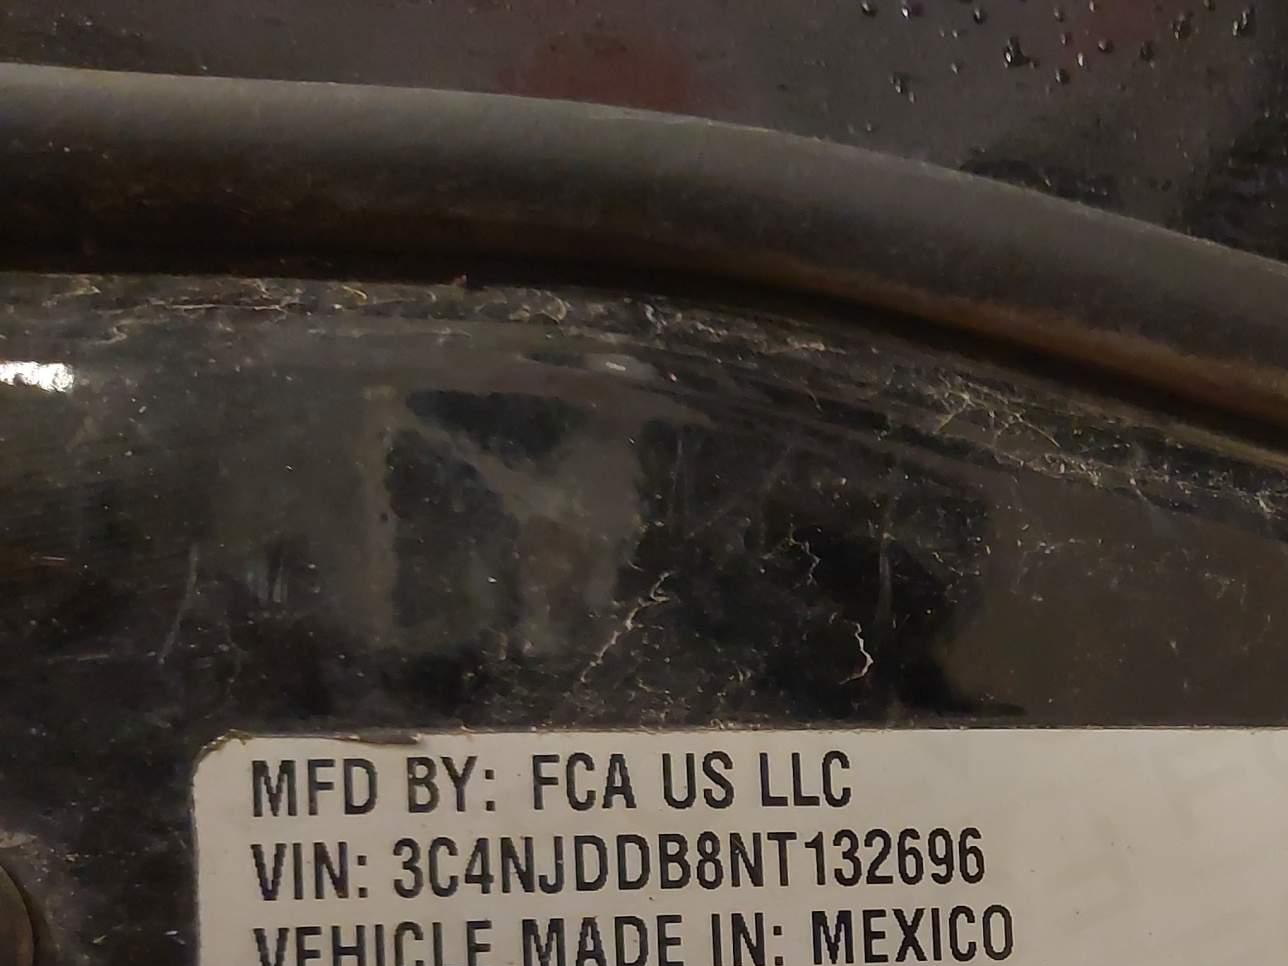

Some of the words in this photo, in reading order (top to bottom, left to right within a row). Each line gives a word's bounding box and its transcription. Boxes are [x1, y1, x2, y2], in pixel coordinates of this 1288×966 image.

[252, 758, 377, 817] MFD
[408, 755, 496, 812] BY:
[533, 753, 637, 810] FCA
[662, 751, 734, 808] US
[760, 751, 852, 806] LLC
[250, 841, 367, 901] VIN:
[393, 828, 985, 898] 3C4NJDDB8NT132696
[811, 904, 1013, 965] MEXICO
